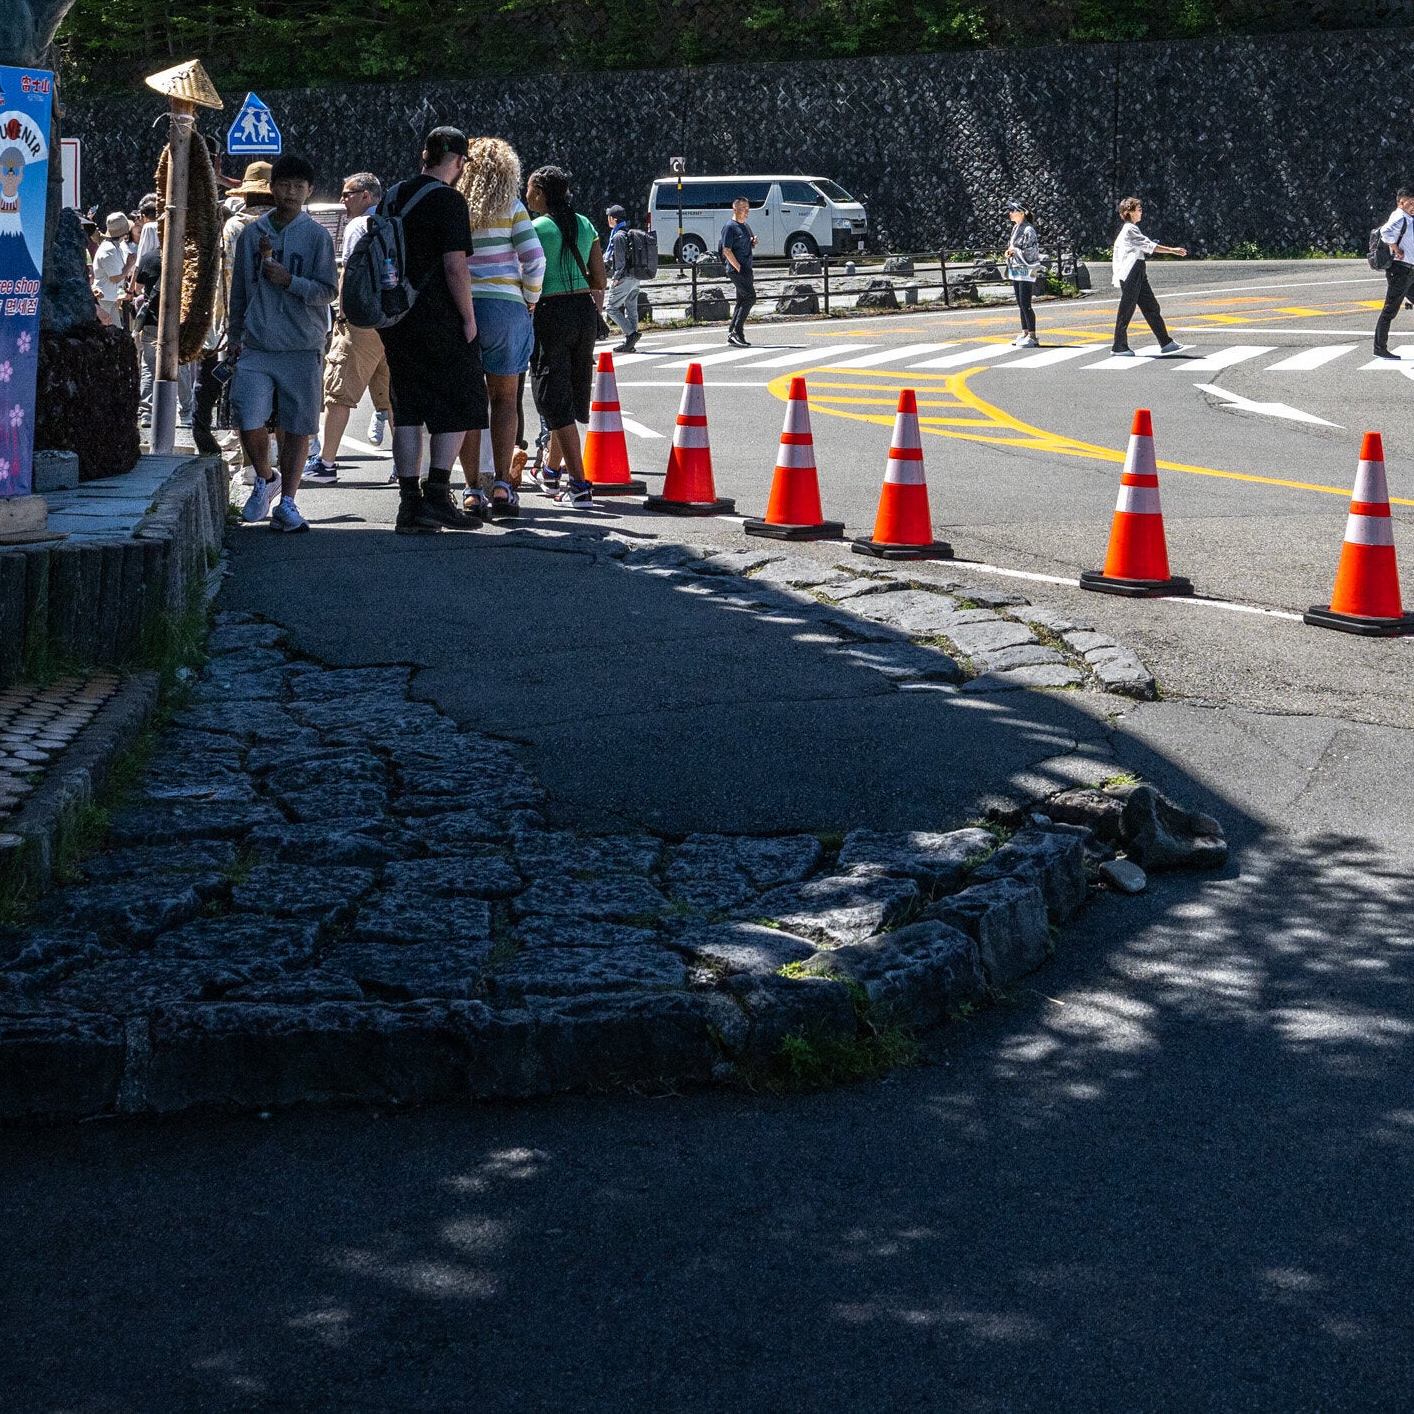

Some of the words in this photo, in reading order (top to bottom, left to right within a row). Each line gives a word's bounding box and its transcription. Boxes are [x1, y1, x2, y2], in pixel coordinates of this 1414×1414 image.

[21, 75, 50, 94] 富士山
[14, 276, 40, 297] shop
